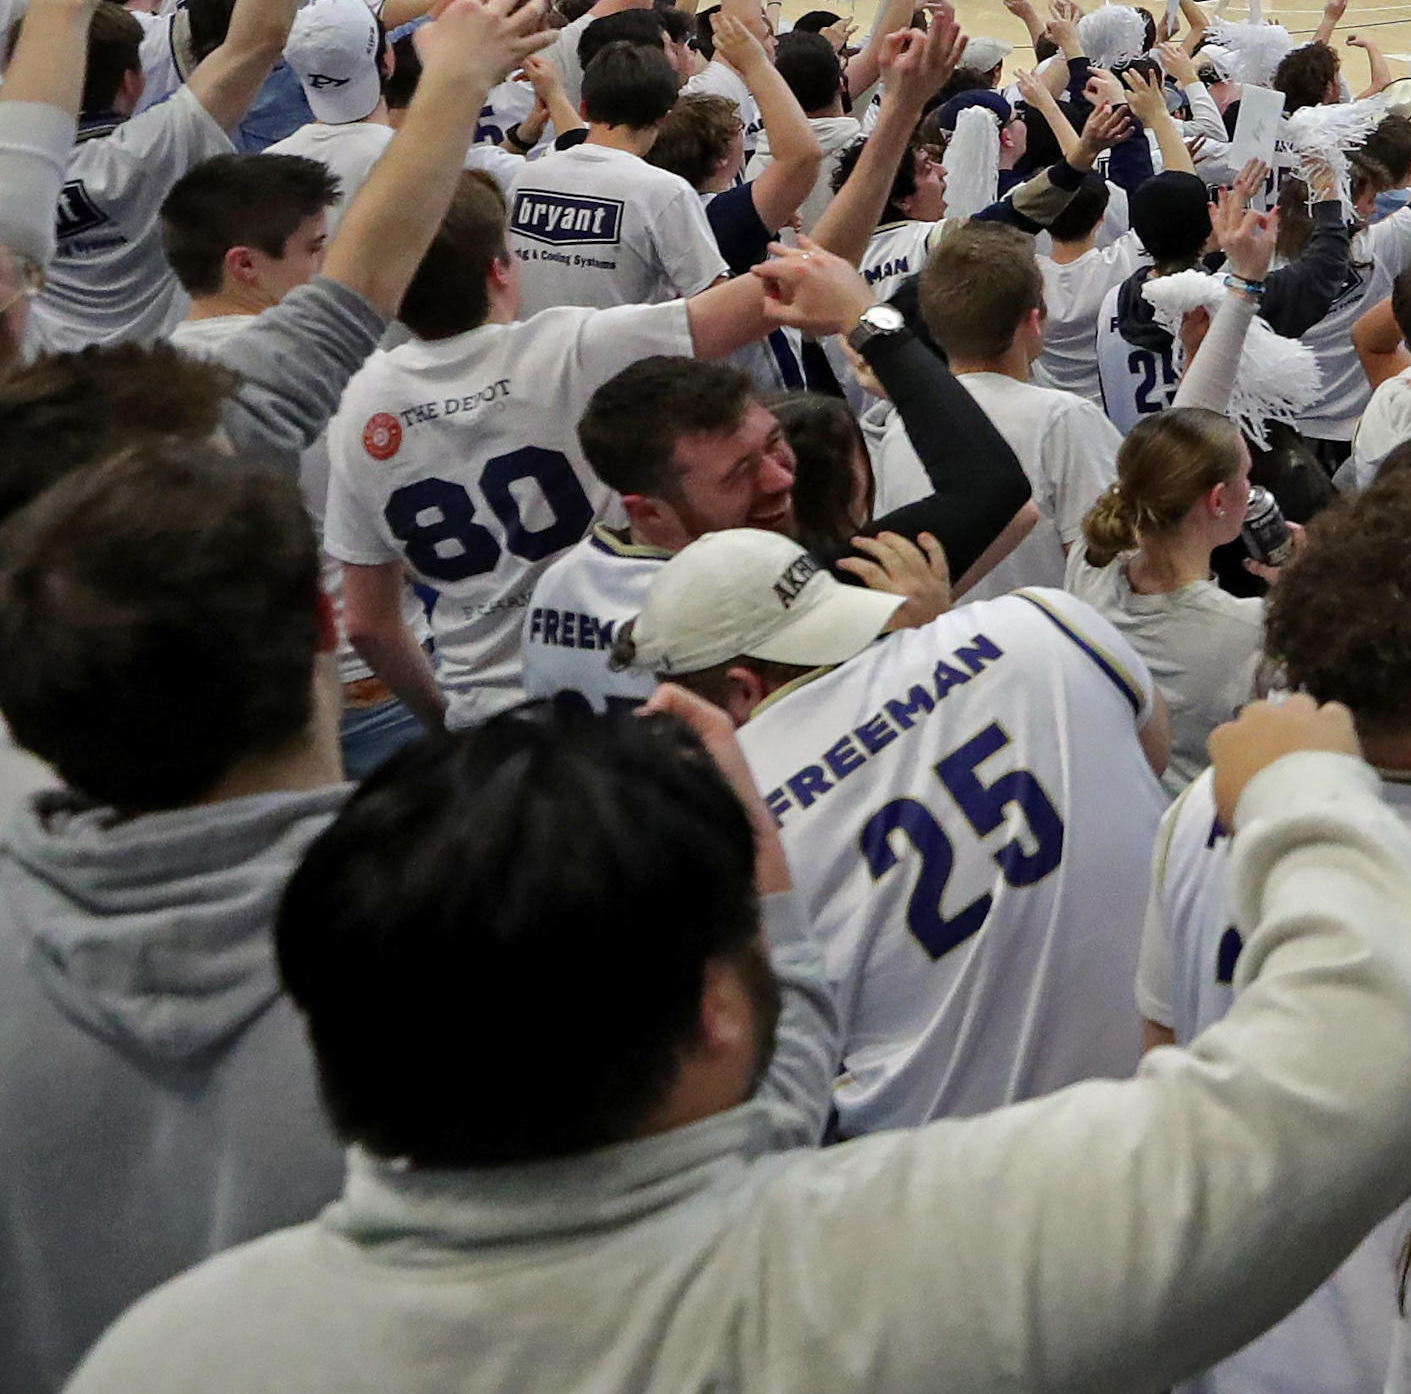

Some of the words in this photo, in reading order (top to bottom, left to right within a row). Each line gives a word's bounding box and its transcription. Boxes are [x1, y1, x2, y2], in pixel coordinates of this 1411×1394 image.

[518, 198, 606, 234] bryant
[400, 402, 439, 427] THE
[384, 445, 595, 582] 80
[761, 632, 1005, 830] FREEMAN
[859, 720, 1065, 964] 25
